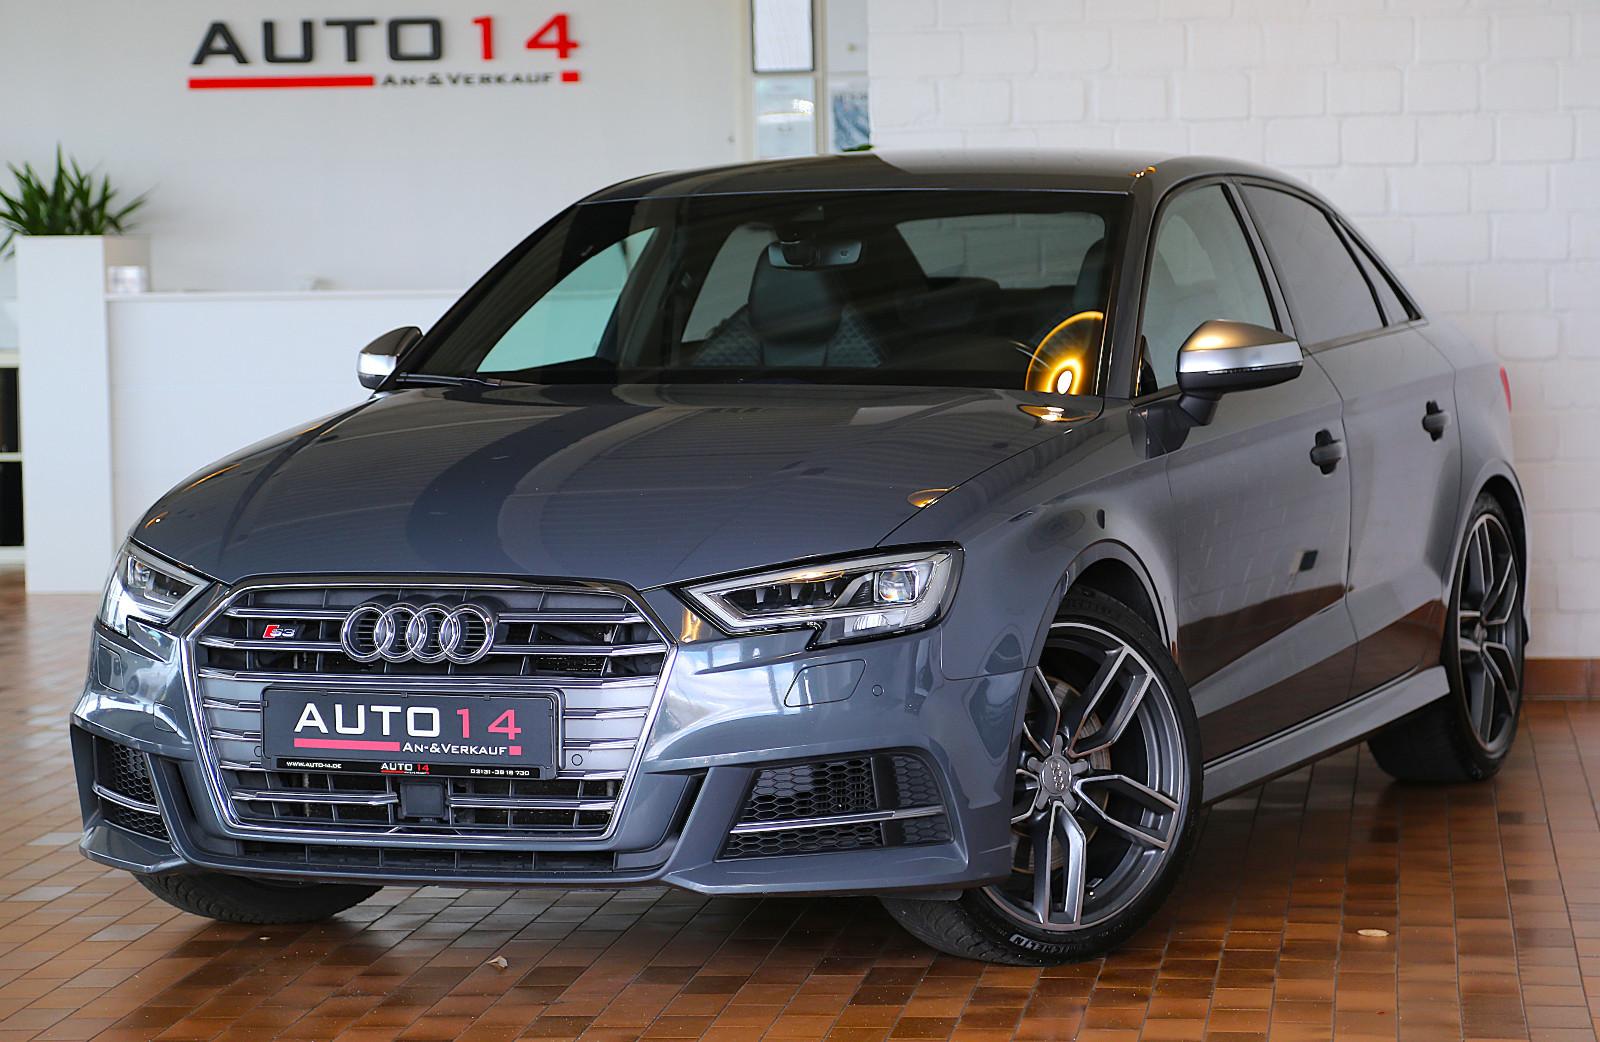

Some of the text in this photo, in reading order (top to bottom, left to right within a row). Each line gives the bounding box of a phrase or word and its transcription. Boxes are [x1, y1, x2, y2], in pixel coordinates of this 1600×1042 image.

[191, 13, 580, 65] AUTO 14
[266, 625, 296, 638] S3
[294, 703, 522, 741] AUTO 14
[380, 762, 429, 772] AUTO 14
